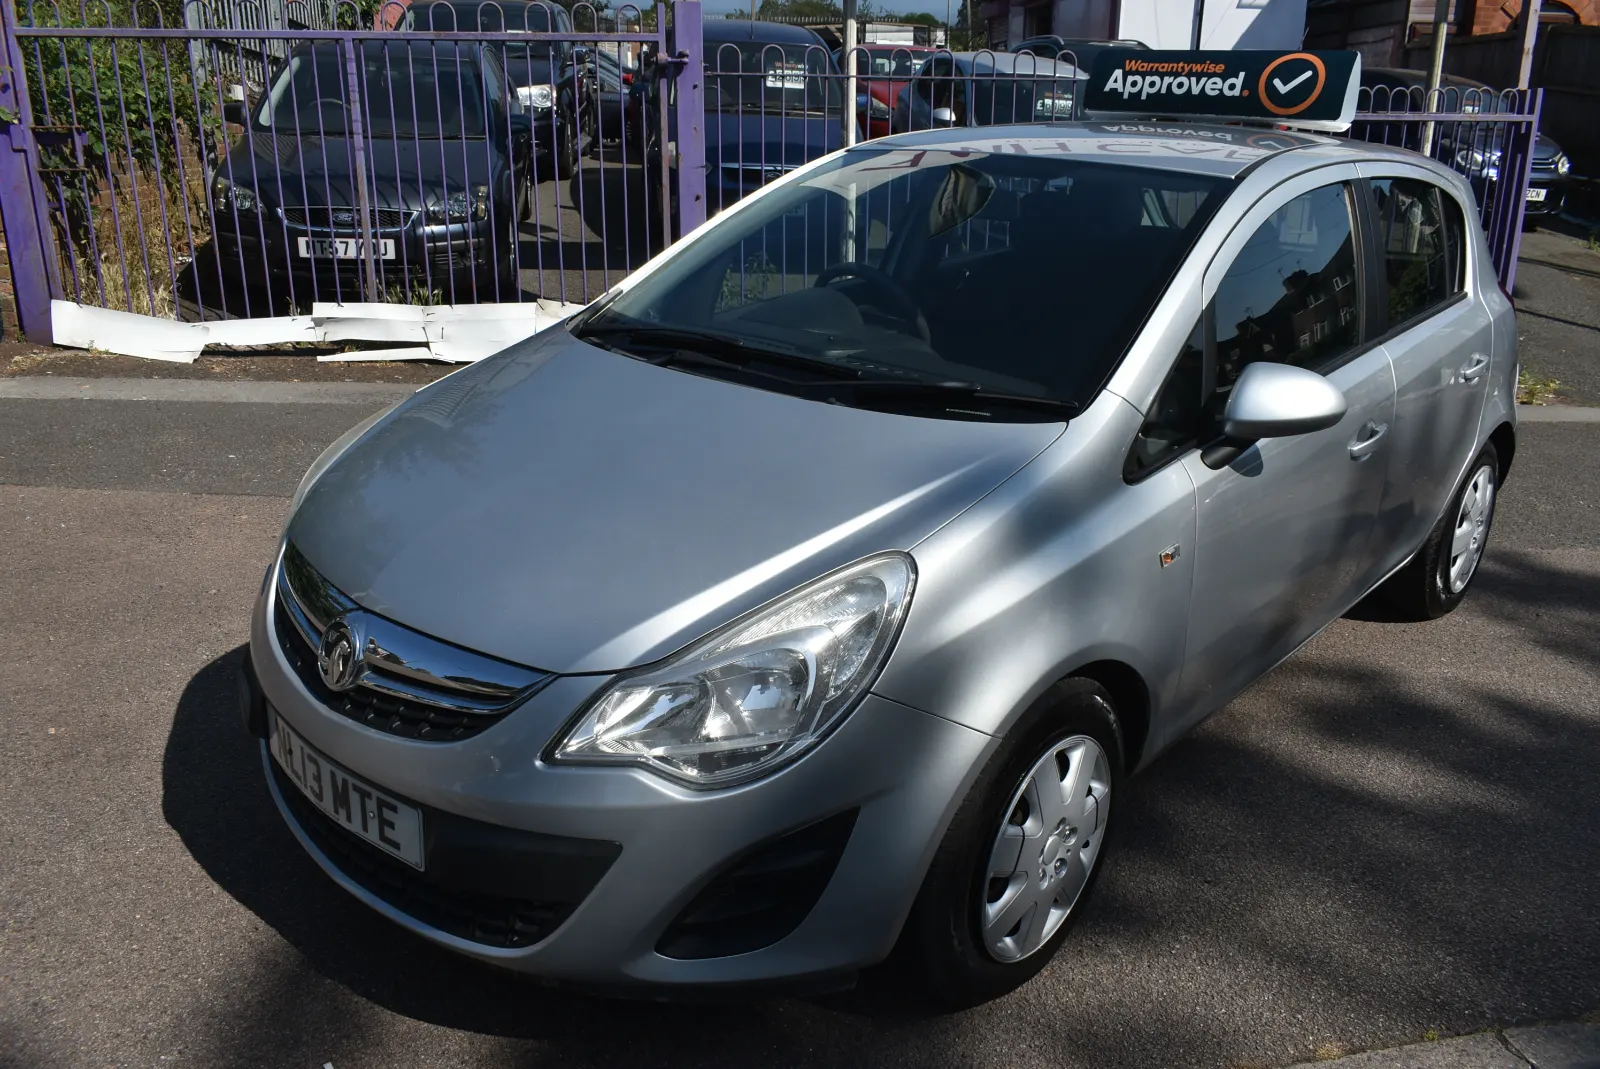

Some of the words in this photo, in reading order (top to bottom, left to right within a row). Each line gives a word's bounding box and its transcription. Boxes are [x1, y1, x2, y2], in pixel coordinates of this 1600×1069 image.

[1125, 59, 1225, 75] Warrantywise
[1103, 69, 1250, 100] Approved.
[276, 716, 323, 803] NL13
[330, 769, 401, 852] MTE
